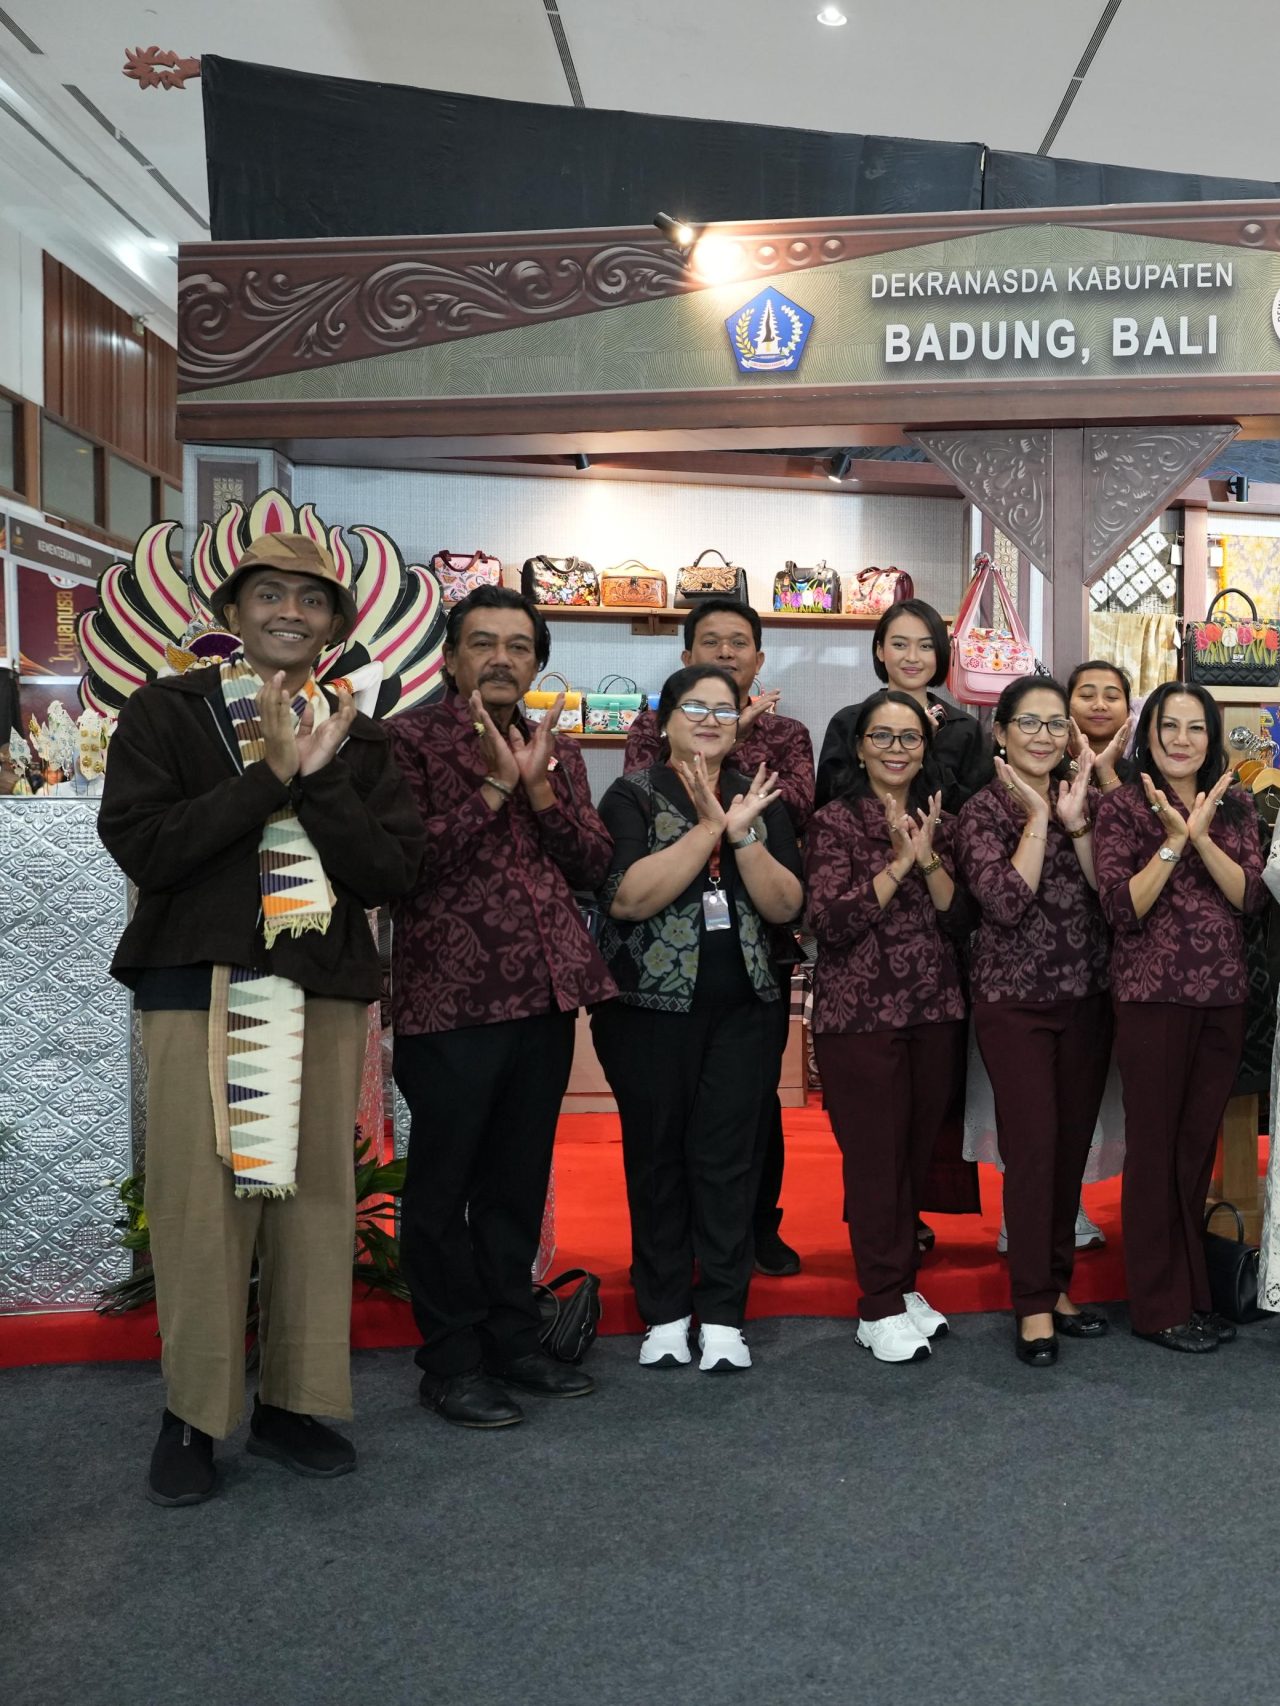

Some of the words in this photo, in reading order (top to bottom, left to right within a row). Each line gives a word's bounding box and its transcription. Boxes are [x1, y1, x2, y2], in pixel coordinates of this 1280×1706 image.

[871, 268, 1058, 298] DEKRANASDA
[1067, 262, 1233, 292] KABUPATEN
[885, 319, 1090, 365] BADUNG,
[1112, 315, 1218, 357] BALI
